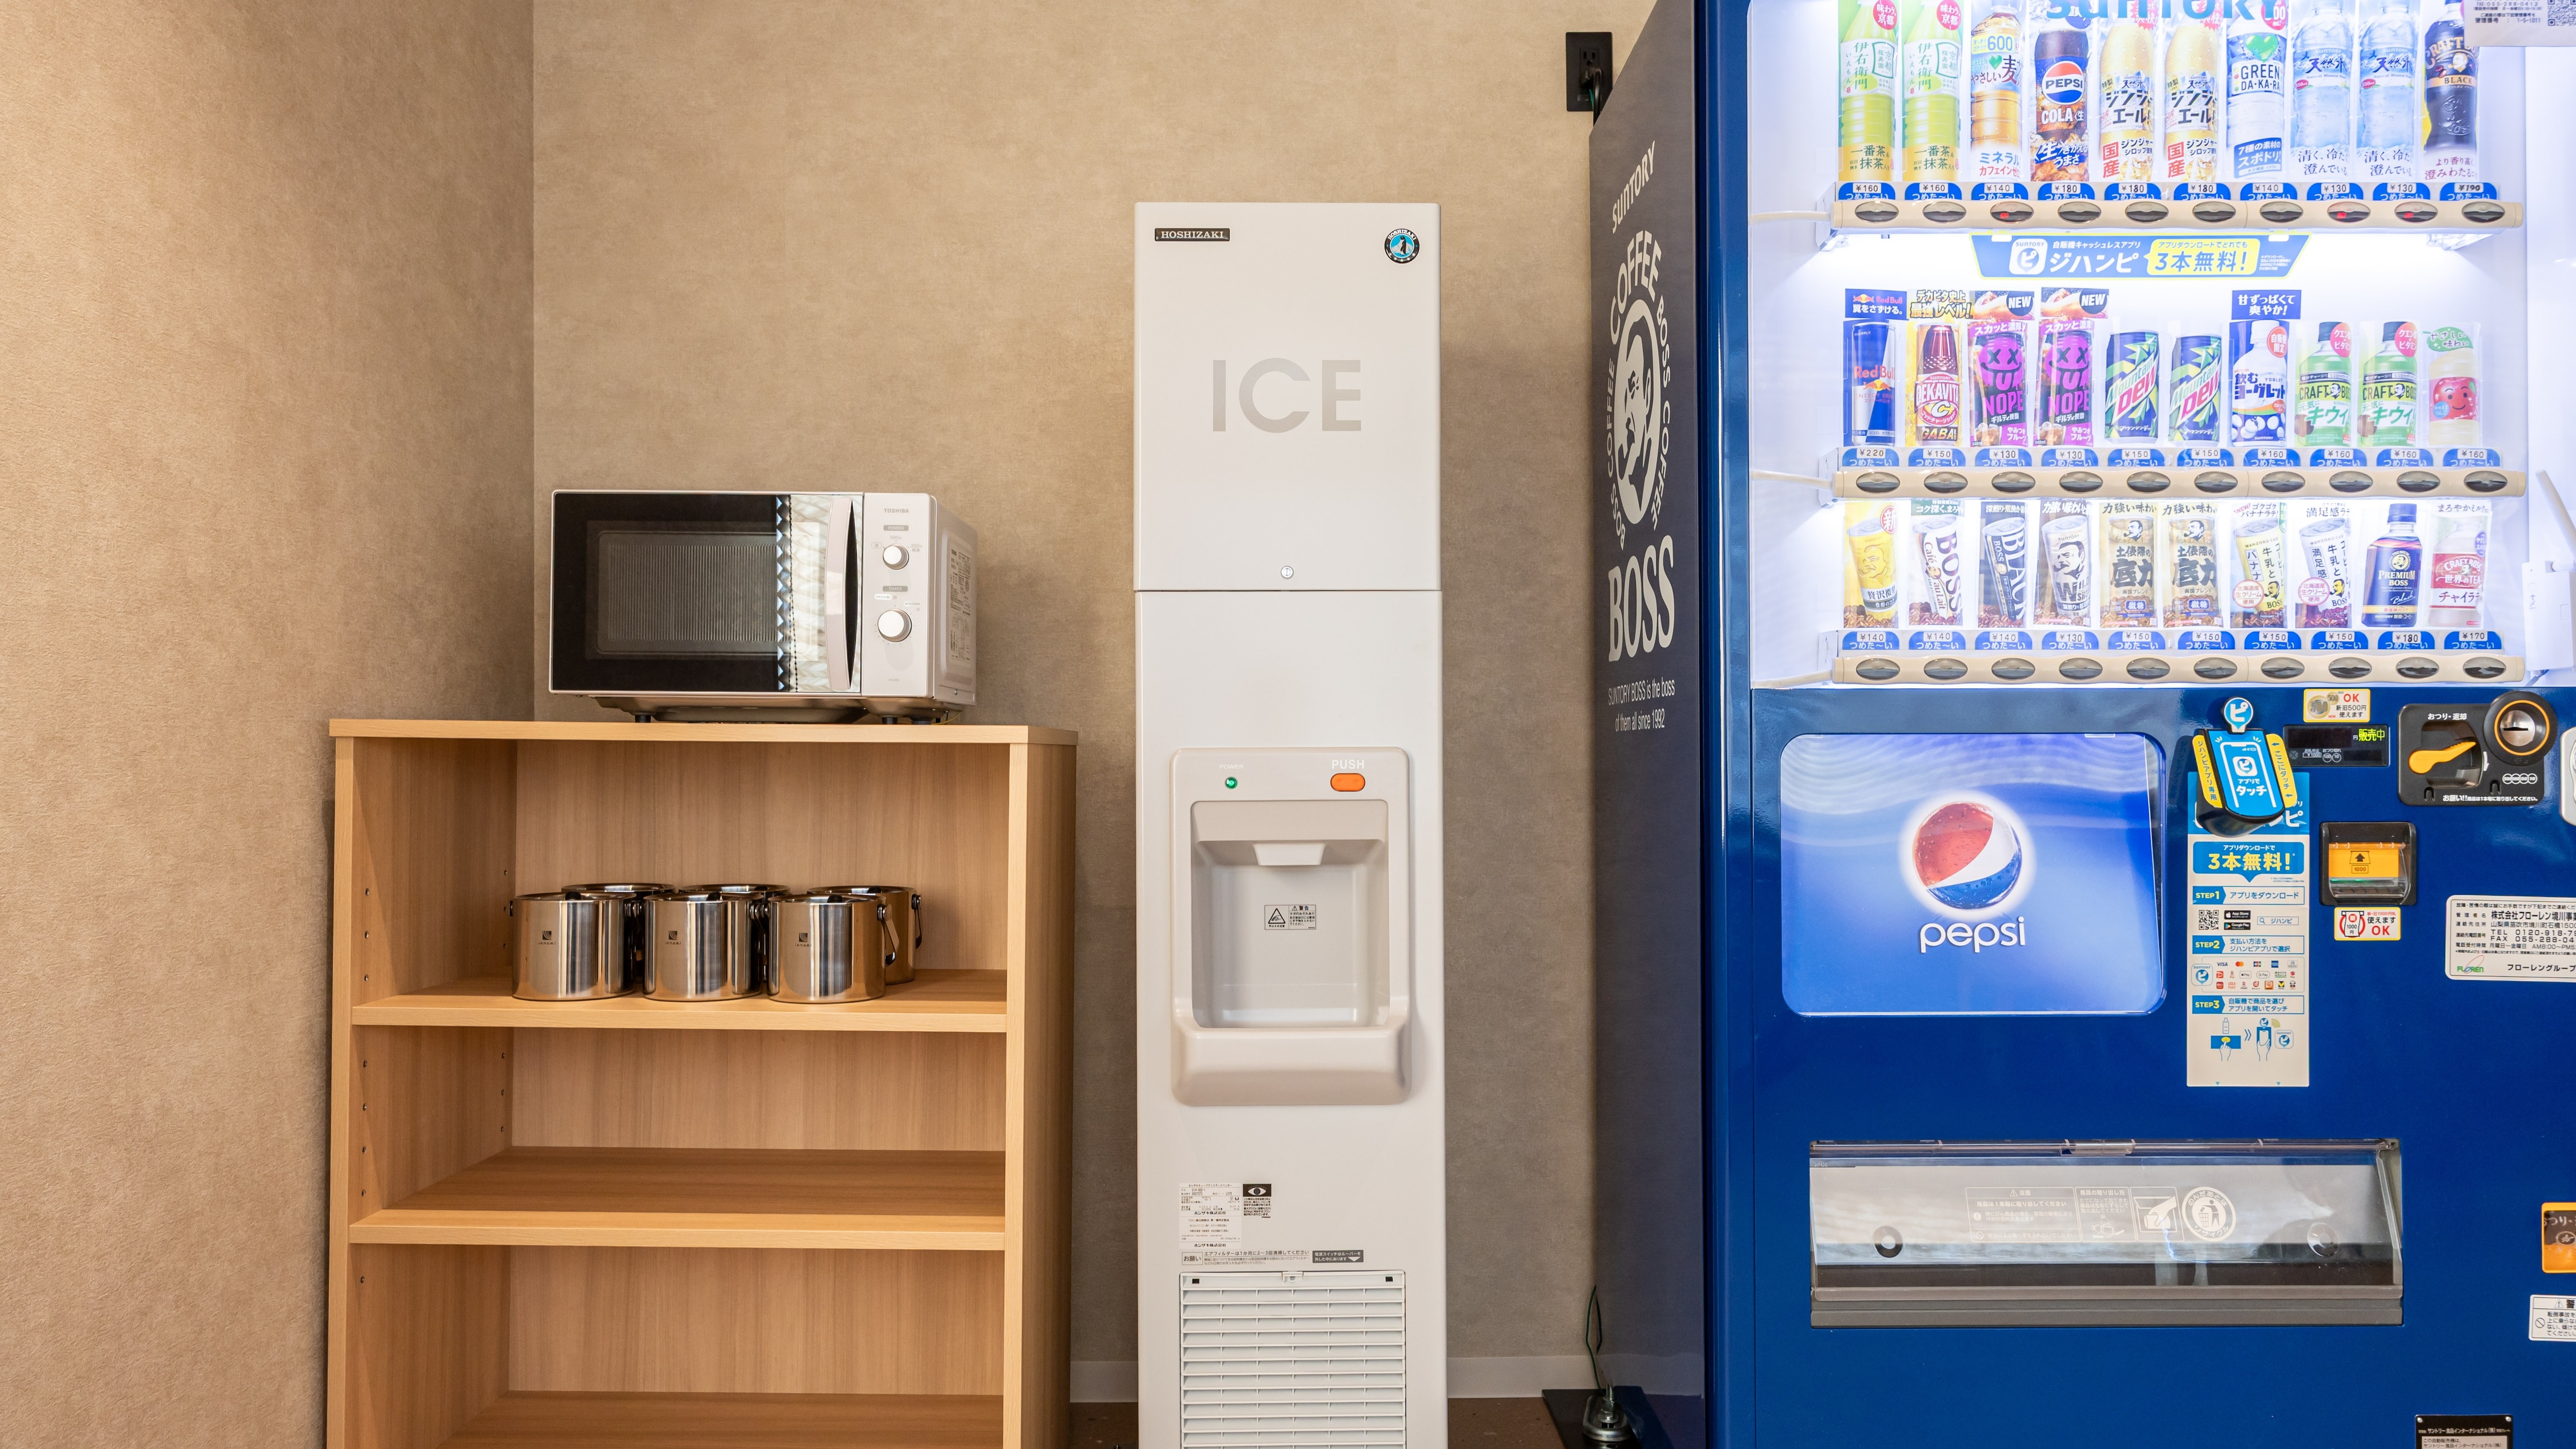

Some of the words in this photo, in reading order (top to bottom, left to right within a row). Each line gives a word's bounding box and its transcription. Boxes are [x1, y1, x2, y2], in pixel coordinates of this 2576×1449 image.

[1878, 14, 1894, 26] 京都
[1941, 14, 1958, 26] 京都
[1987, 36, 2012, 50] 600
[1854, 42, 1869, 90] 伊右衛門
[1917, 42, 1933, 90] 伊右衛門
[2241, 64, 2280, 80] GREEN
[2305, 57, 2346, 74] 天然水
[2372, 57, 2413, 73] 天然水
[2045, 79, 2083, 89] PEPSI
[2444, 76, 2472, 84] BLACK
[2041, 108, 2073, 124] COLA
[2054, 154, 2079, 168] うまさ
[2102, 142, 2120, 178] 国産
[2167, 142, 2185, 178] 国産
[1612, 140, 1655, 234] SUNTORY
[1856, 184, 1878, 192] ¥160
[1986, 184, 2010, 192] ¥140
[2054, 184, 2077, 193] ¥180
[2121, 184, 2144, 193] ¥180
[2191, 184, 2213, 193] ¥180
[2255, 184, 2279, 192] ¥140
[2324, 184, 2347, 193] ¥130
[2390, 184, 2413, 193] ¥130
[1387, 229, 1417, 241] HOSHIZAKI
[2052, 241, 2141, 249] 自販機キャッシュレスアプリ
[2158, 241, 2248, 249] アプリダウンロードでどれでも
[2049, 252, 2139, 274] ジハンピ
[2155, 251, 2248, 273] 3本無料!
[1611, 230, 1662, 345] COFFEE
[2008, 296, 2031, 309] NEW
[2081, 294, 2106, 306] NEW
[2238, 294, 2296, 305] 甘ずっぱくて
[1853, 304, 1903, 315] 翼をさずける。
[2249, 305, 2287, 316] 爽やか!
[1657, 295, 1670, 388] BOSS
[2430, 332, 2467, 340] やさしい
[1854, 365, 1878, 379] Red
[1879, 366, 1895, 380] Bull
[2235, 372, 2258, 385] 飲む
[1213, 357, 1361, 433] ICE
[2299, 384, 2327, 400] CRAFT
[2363, 385, 2392, 400] CRAFT
[1984, 391, 2024, 416] NOPE
[2048, 390, 2090, 417] NOPE
[1606, 357, 1616, 478] COFFEE
[1993, 450, 2015, 458] ¥130
[2261, 450, 2283, 458] ¥160
[1651, 400, 1670, 531] COFFEE
[2102, 502, 2157, 514] 力強い味わい
[1610, 485, 1625, 551] BOSS
[1883, 510, 1896, 530] 新
[1993, 540, 2004, 562] BOSS
[2116, 546, 2150, 557] 土俵際の
[2177, 546, 2213, 557] 土俵際の
[2247, 551, 2261, 580] バナナ
[2262, 547, 2276, 578] 牛乳と
[2312, 548, 2327, 578] 満足感
[2327, 544, 2341, 576] 牛乳と
[2444, 558, 2468, 572] CRAFT
[2110, 558, 2153, 588] 底力
[2378, 570, 2415, 580] PREMIUM
[1608, 535, 1675, 662] BOSS
[2267, 599, 2283, 609] BOSS
[2332, 598, 2348, 607] BOSS
[2059, 634, 2082, 642] ¥130
[2395, 634, 2418, 642] ¥180
[1608, 684, 1631, 705] SUNTORY
[1631, 680, 1646, 702] BOSS
[1647, 680, 1651, 699] is
[1662, 677, 1674, 697] boss
[2344, 693, 2359, 702] OK
[2230, 702, 2247, 722] ピ
[1615, 713, 1620, 731] of
[1620, 714, 1631, 731] them
[1638, 711, 1650, 730] since
[1652, 708, 1665, 728] 1992
[2359, 728, 2385, 741] 販売中
[1331, 759, 1365, 769] PUSH
[2197, 741, 2217, 801] ジハンピアプリ専用
[2274, 751, 2290, 790] ここにタッチ
[2235, 786, 2267, 796] タッチ
[2208, 852, 2291, 871] 3本無料!
[2196, 891, 2219, 899] STEP1
[1919, 916, 2025, 953] pepsi
[2371, 926, 2390, 935] OK
[2195, 940, 2220, 949] STEP2
[2195, 1000, 2219, 1009] STEP3
[2188, 1190, 2227, 1209] のんだあとは
[2193, 1223, 2230, 1238] リサイクル
